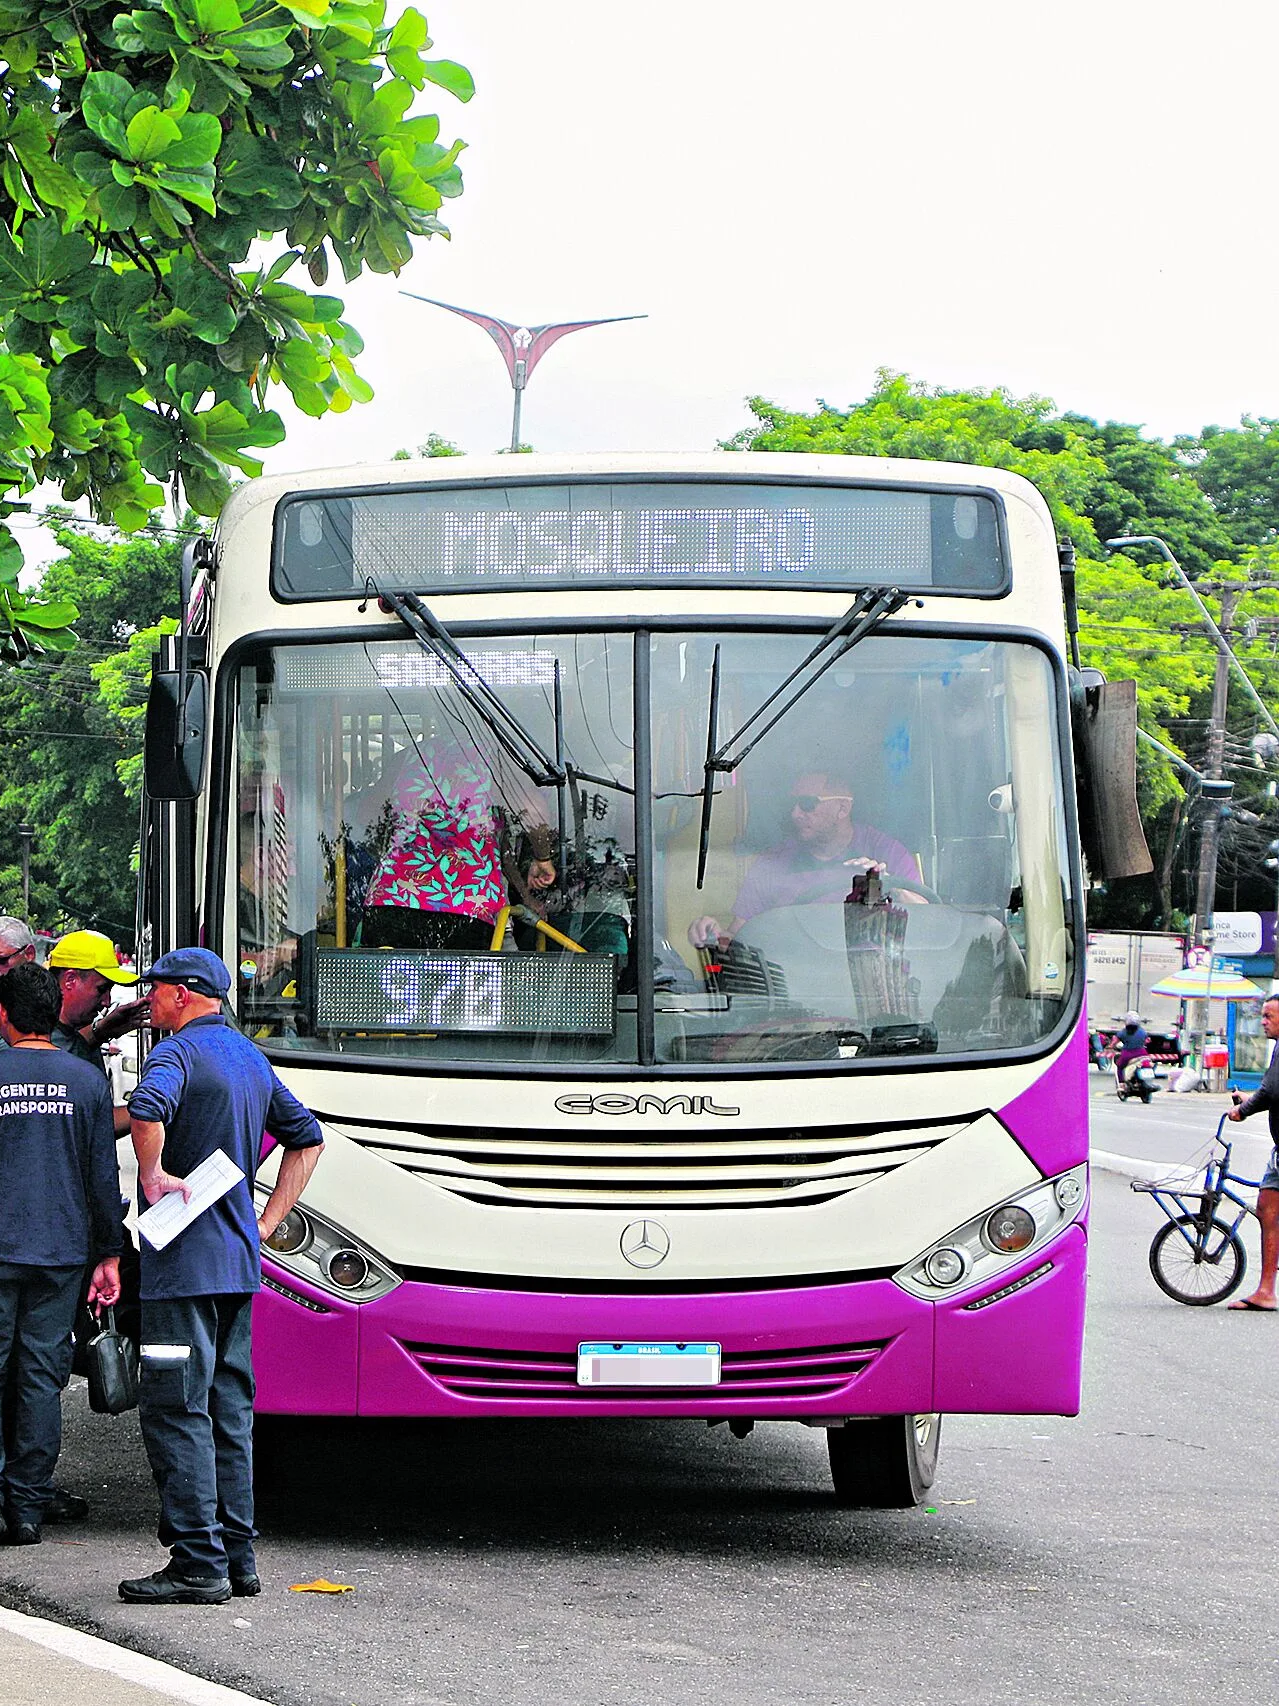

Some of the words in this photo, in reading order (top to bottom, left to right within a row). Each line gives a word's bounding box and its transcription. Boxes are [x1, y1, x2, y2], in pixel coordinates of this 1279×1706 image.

[444, 508, 815, 575] MOSQUEIRO
[1232, 929, 1258, 940] Store
[381, 959, 502, 1025] 970
[47, 1084, 67, 1098] DE
[554, 1093, 740, 1116] COMIL
